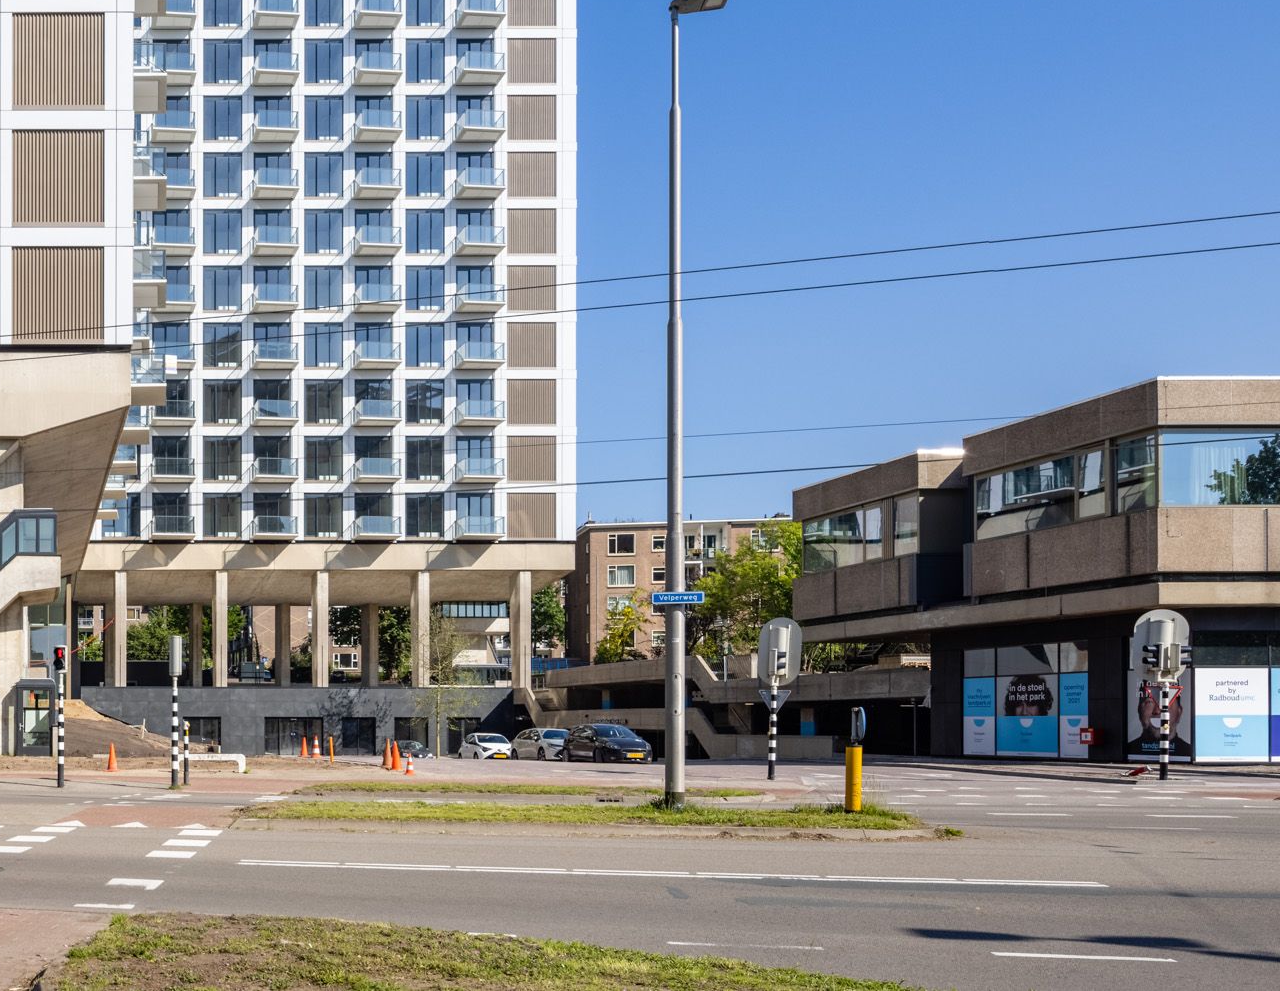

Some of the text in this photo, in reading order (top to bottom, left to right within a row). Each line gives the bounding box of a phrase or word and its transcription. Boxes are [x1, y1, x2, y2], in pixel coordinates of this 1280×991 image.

[1017, 683, 1026, 691] de
[1027, 683, 1045, 691] stoel
[1215, 679, 1249, 687] partnered
[1008, 692, 1046, 702] in het park
